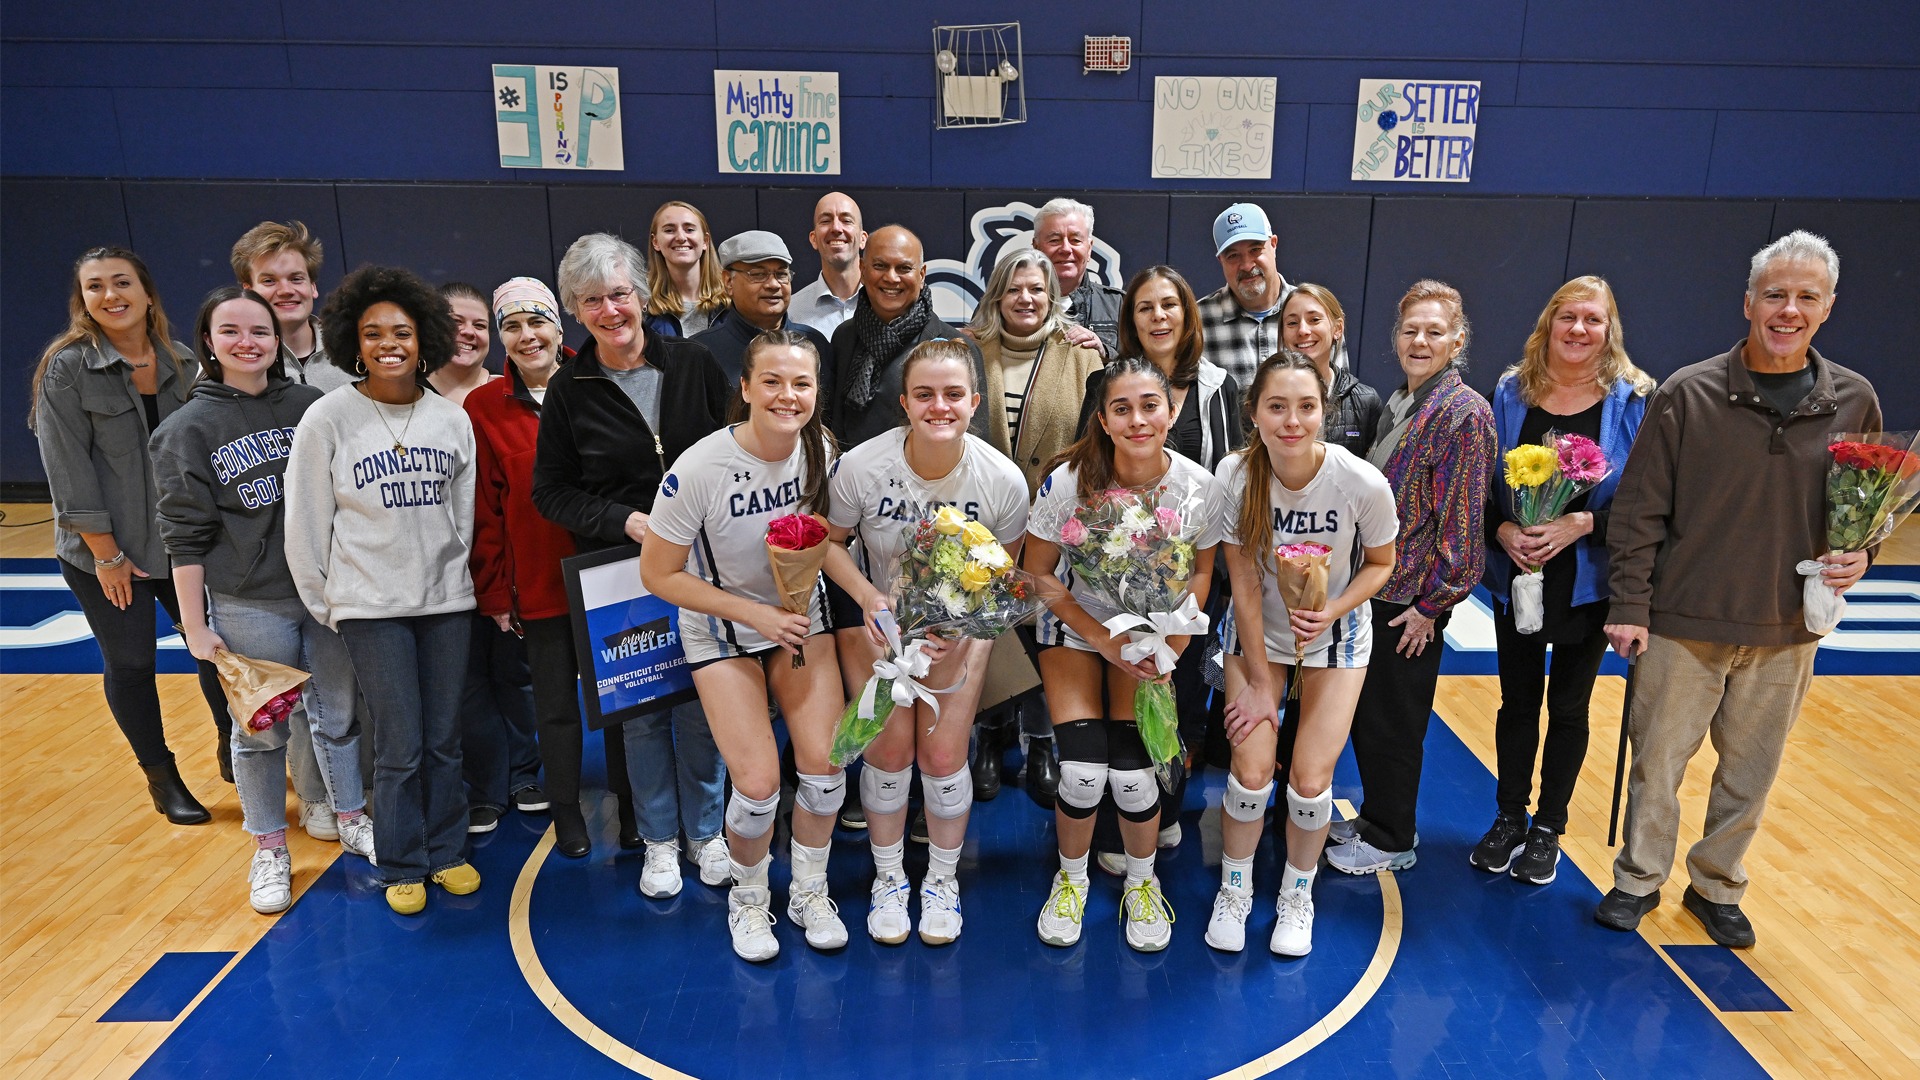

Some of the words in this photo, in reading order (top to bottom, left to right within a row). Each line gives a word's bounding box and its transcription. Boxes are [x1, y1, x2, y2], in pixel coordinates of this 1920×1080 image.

[549, 71, 568, 91] IS
[726, 78, 793, 118] Mighty
[799, 76, 836, 118] Fine
[1157, 77, 1201, 110] NO
[1217, 77, 1275, 112] ONE
[576, 68, 617, 168] P
[1359, 83, 1402, 122] OUR
[1399, 82, 1480, 124] SETTER
[1411, 122, 1426, 134] IS
[727, 119, 831, 173] Caroline
[1155, 142, 1242, 176] LIKE
[1352, 130, 1397, 181] JUST
[1394, 135, 1474, 179] BETTER
[237, 473, 285, 509] COL
[380, 480, 446, 508] COLLEG
[1272, 507, 1338, 535] MELS
[600, 631, 677, 664] WHEELER
[596, 666, 653, 689] CONNECTICUT
[654, 656, 688, 672] COLLEGE
[624, 673, 664, 689] VOLLEYBALL
